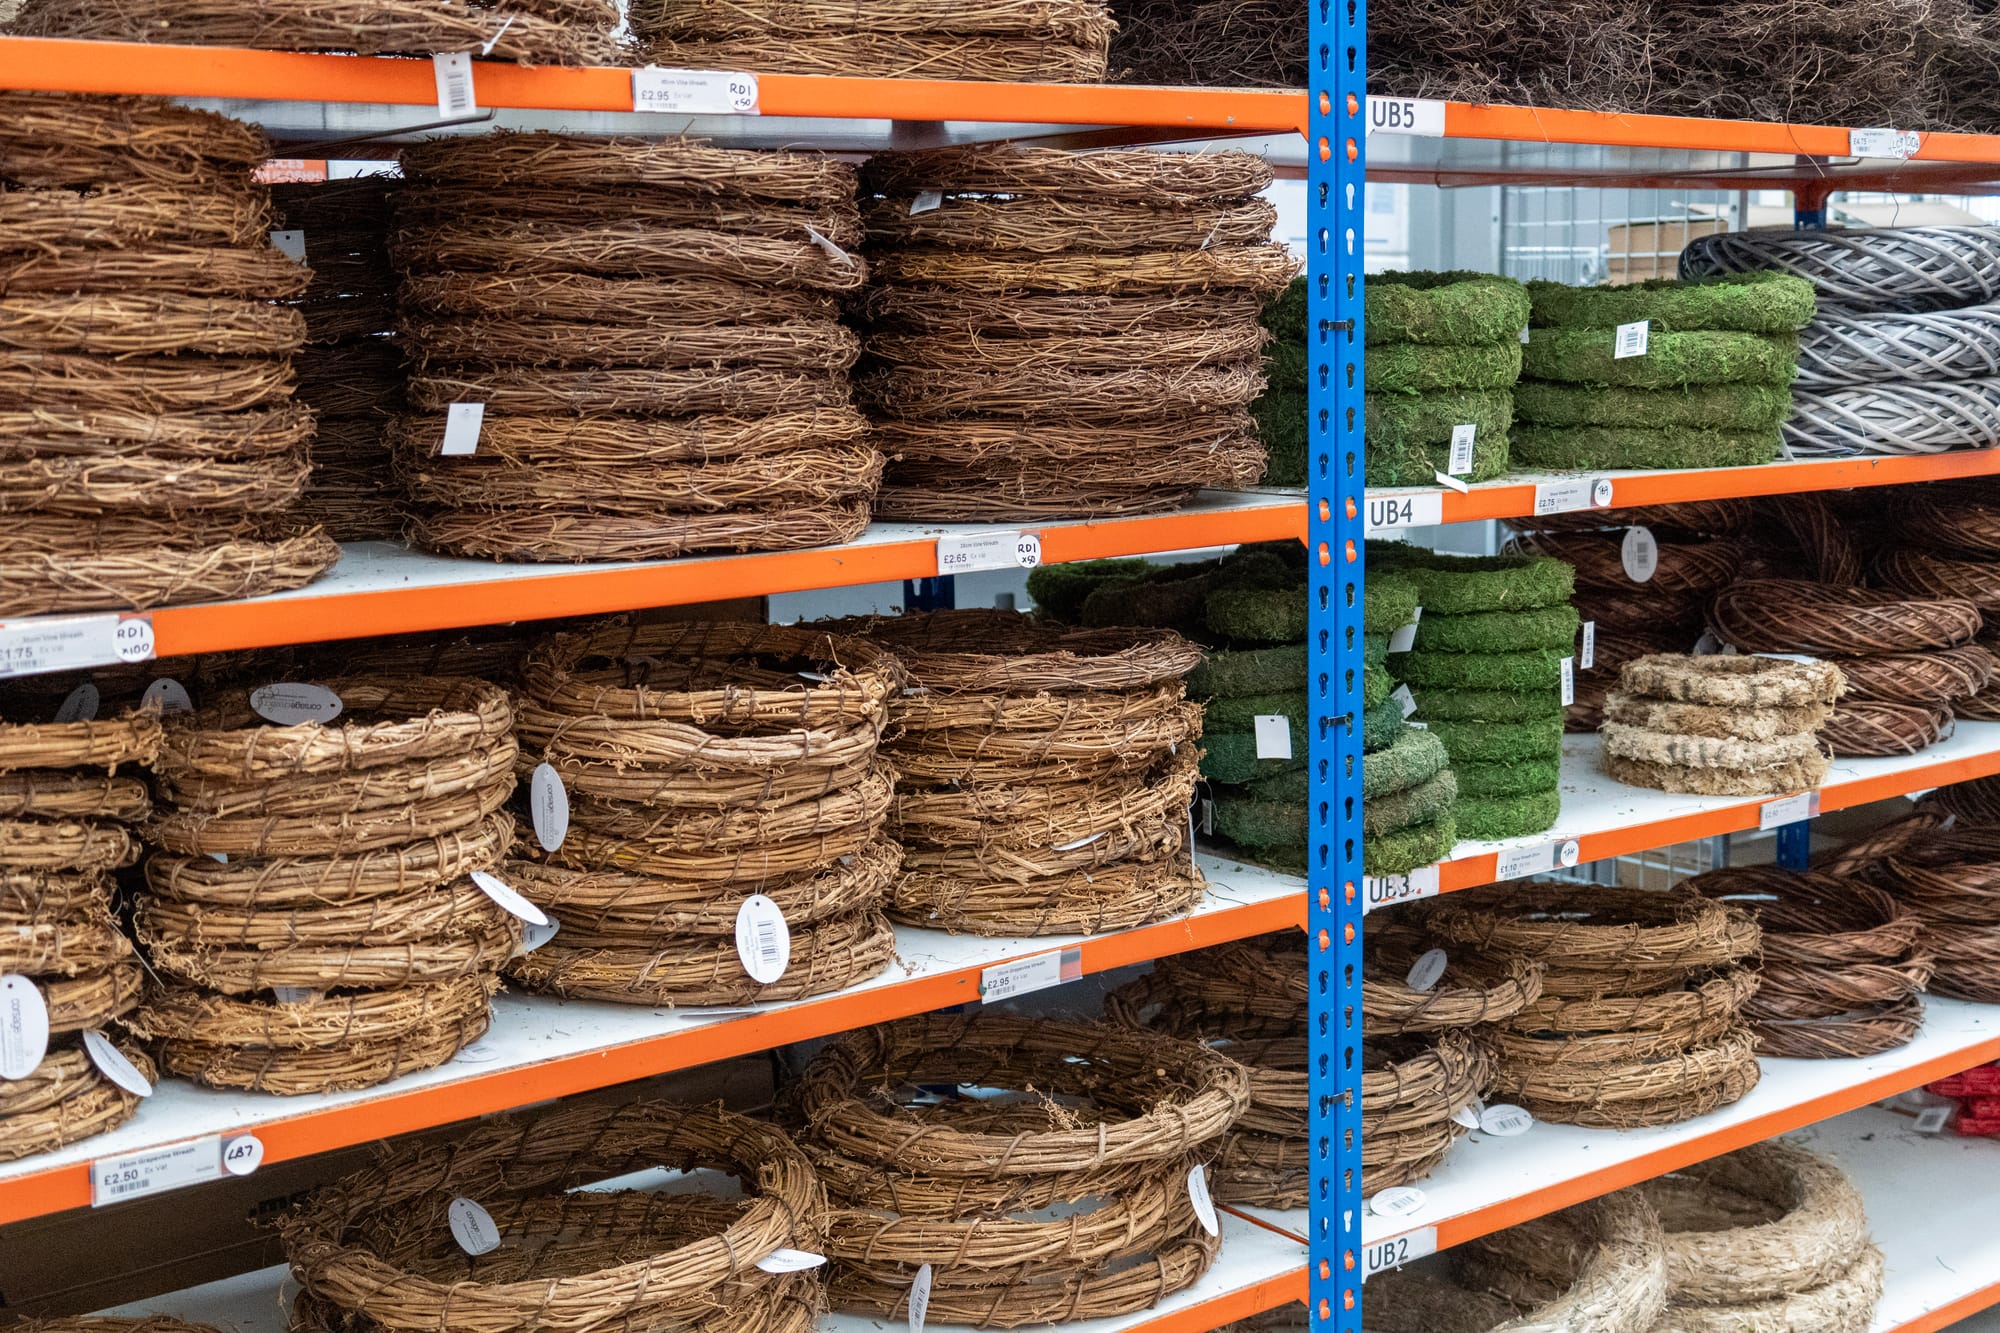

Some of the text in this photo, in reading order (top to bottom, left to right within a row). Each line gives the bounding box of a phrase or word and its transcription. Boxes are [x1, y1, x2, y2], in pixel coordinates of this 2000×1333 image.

[641, 90, 669, 101] £2.95
[1373, 100, 1414, 128] UB5
[1371, 498, 1413, 526] UB4
[944, 553, 967, 564] £2.65
[987, 976, 1010, 989] £2.95
[104, 1169, 139, 1186] £2.50
[1368, 1237, 1409, 1271] UB2
